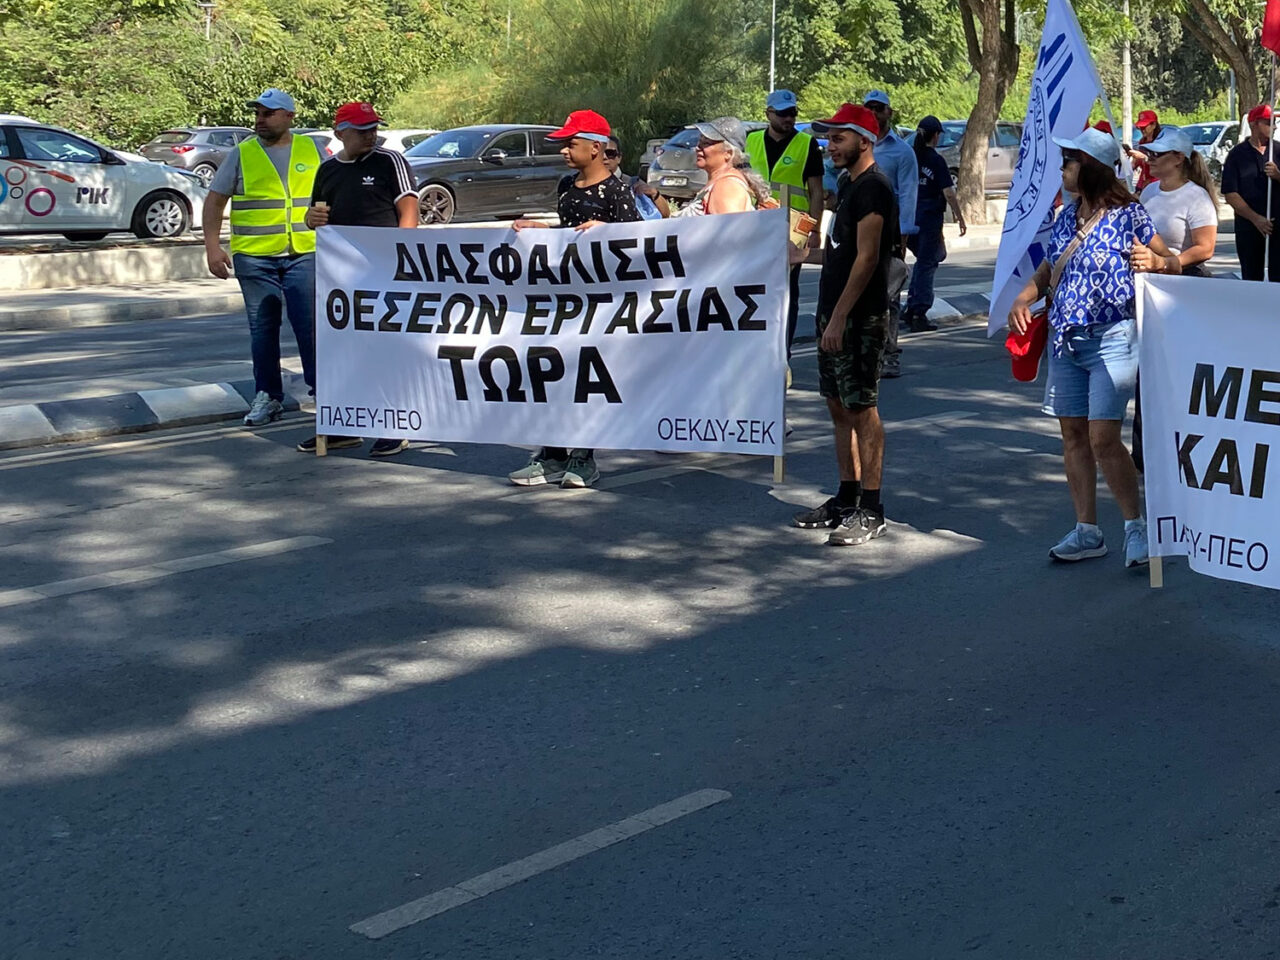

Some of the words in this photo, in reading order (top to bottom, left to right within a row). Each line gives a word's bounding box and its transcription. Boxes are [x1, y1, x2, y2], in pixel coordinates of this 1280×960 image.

[393, 235, 686, 286] ΔΙΑΣΦΑΛΙΣΗ
[326, 289, 509, 335] ΘΕΣΕΩΝ
[520, 284, 767, 335] ΕΡΓΑΣΙΑΣ
[437, 345, 623, 404] ΤΩΡΑ
[320, 406, 422, 431] ΠΑΣΕΥ-ΠΕΟ
[657, 417, 776, 446] ΟΕΚΔΥ-ΣΕΚ
[1175, 431, 1270, 500] ΚΑΙ
